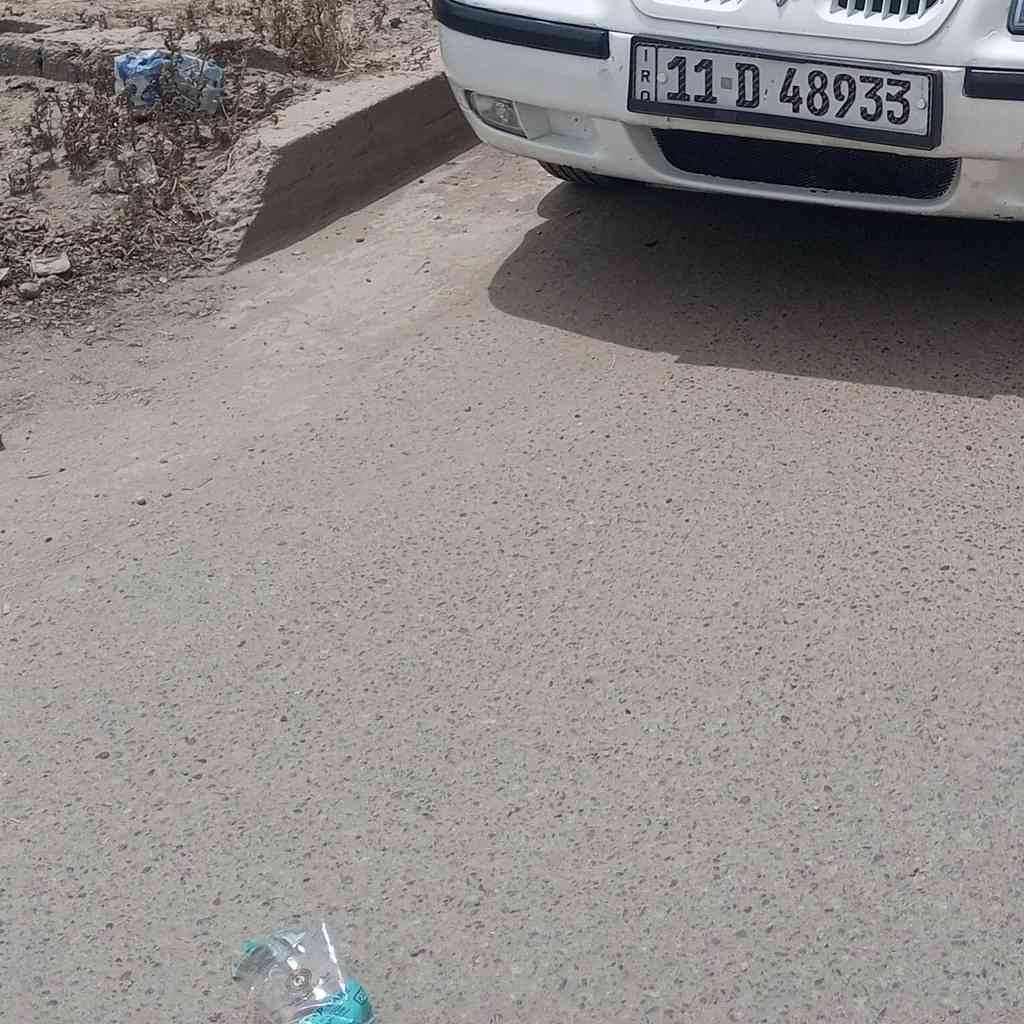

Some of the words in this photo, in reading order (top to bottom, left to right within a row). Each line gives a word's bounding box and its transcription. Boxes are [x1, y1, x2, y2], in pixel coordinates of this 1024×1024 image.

[667, 56, 717, 103] 11
[735, 62, 760, 108] D
[779, 67, 911, 125] 48933
